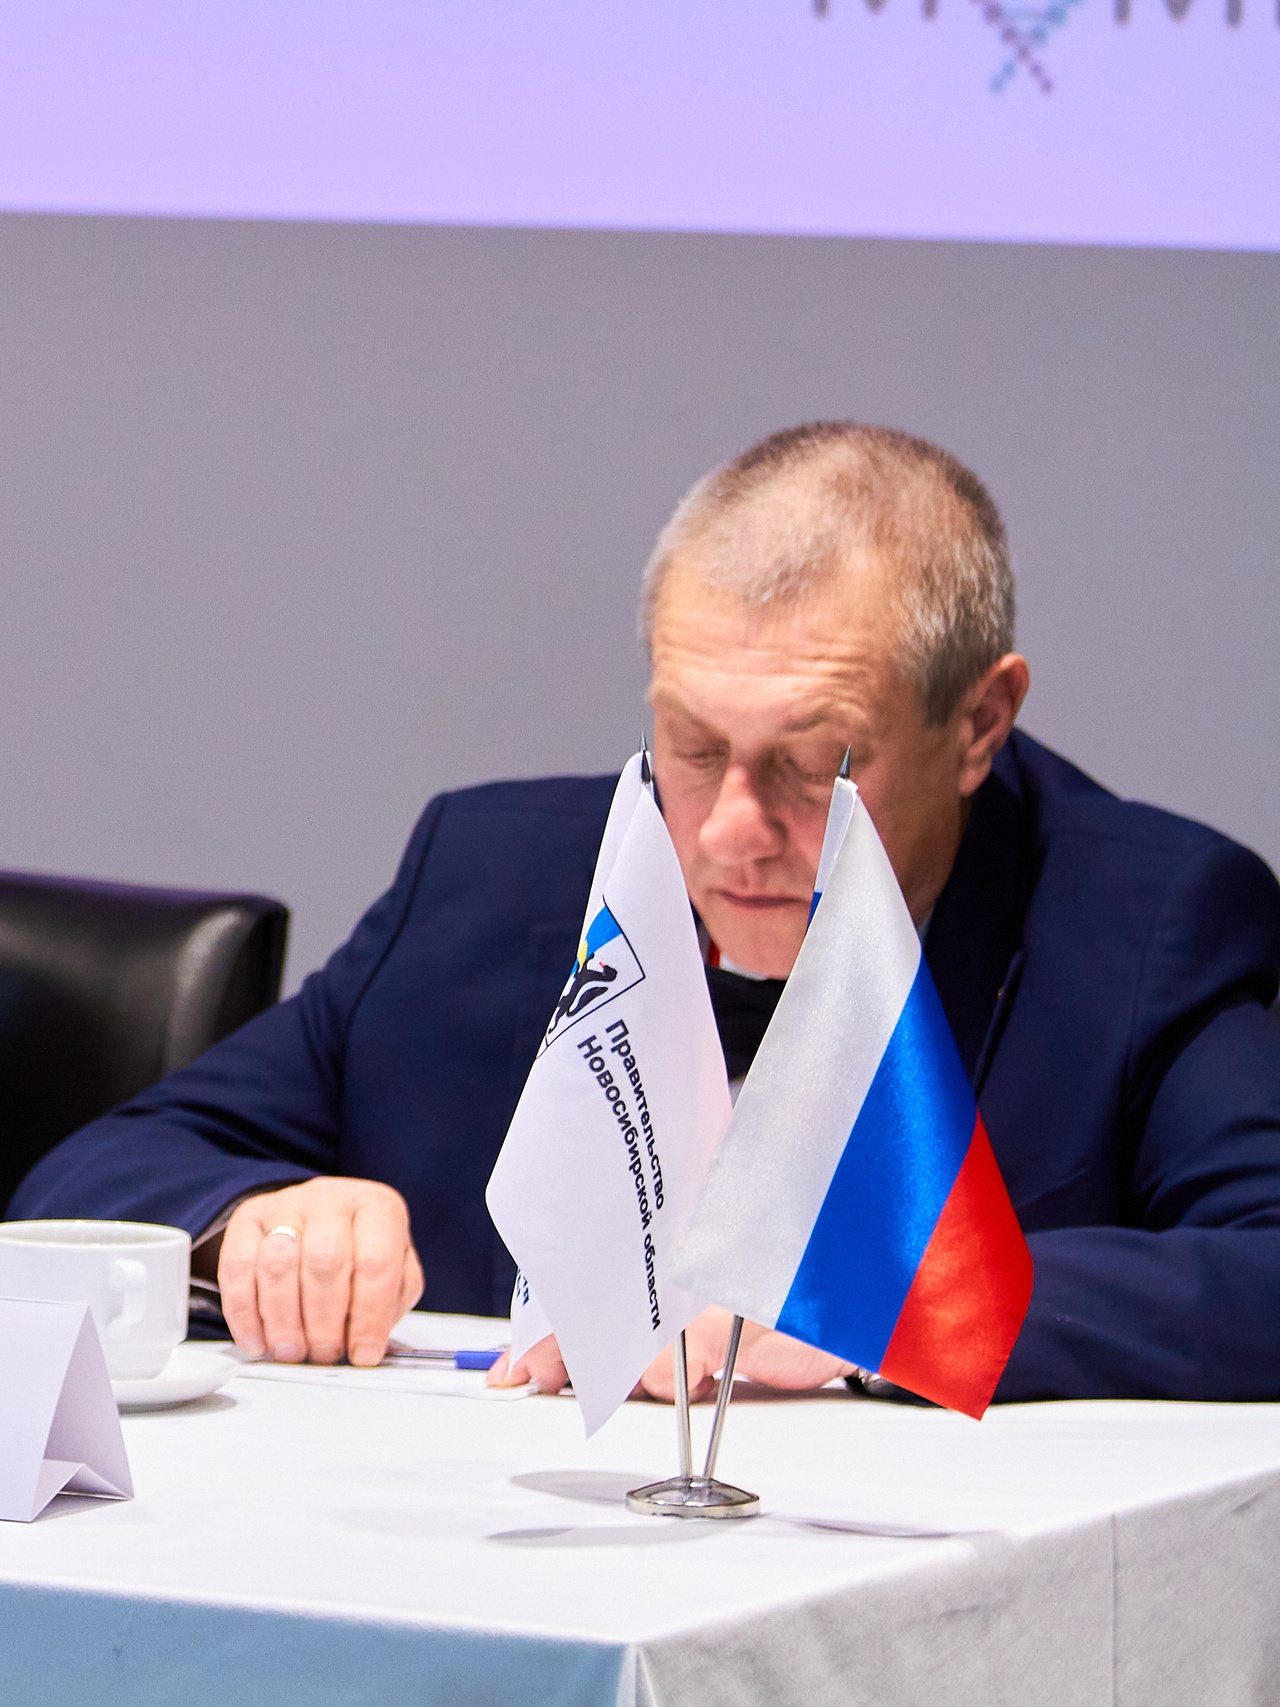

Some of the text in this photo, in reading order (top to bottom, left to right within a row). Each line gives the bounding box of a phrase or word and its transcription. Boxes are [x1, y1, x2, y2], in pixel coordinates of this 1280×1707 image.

[576, 1034, 661, 1331] Новосибирской области
[605, 1018, 665, 1210] Правительство
